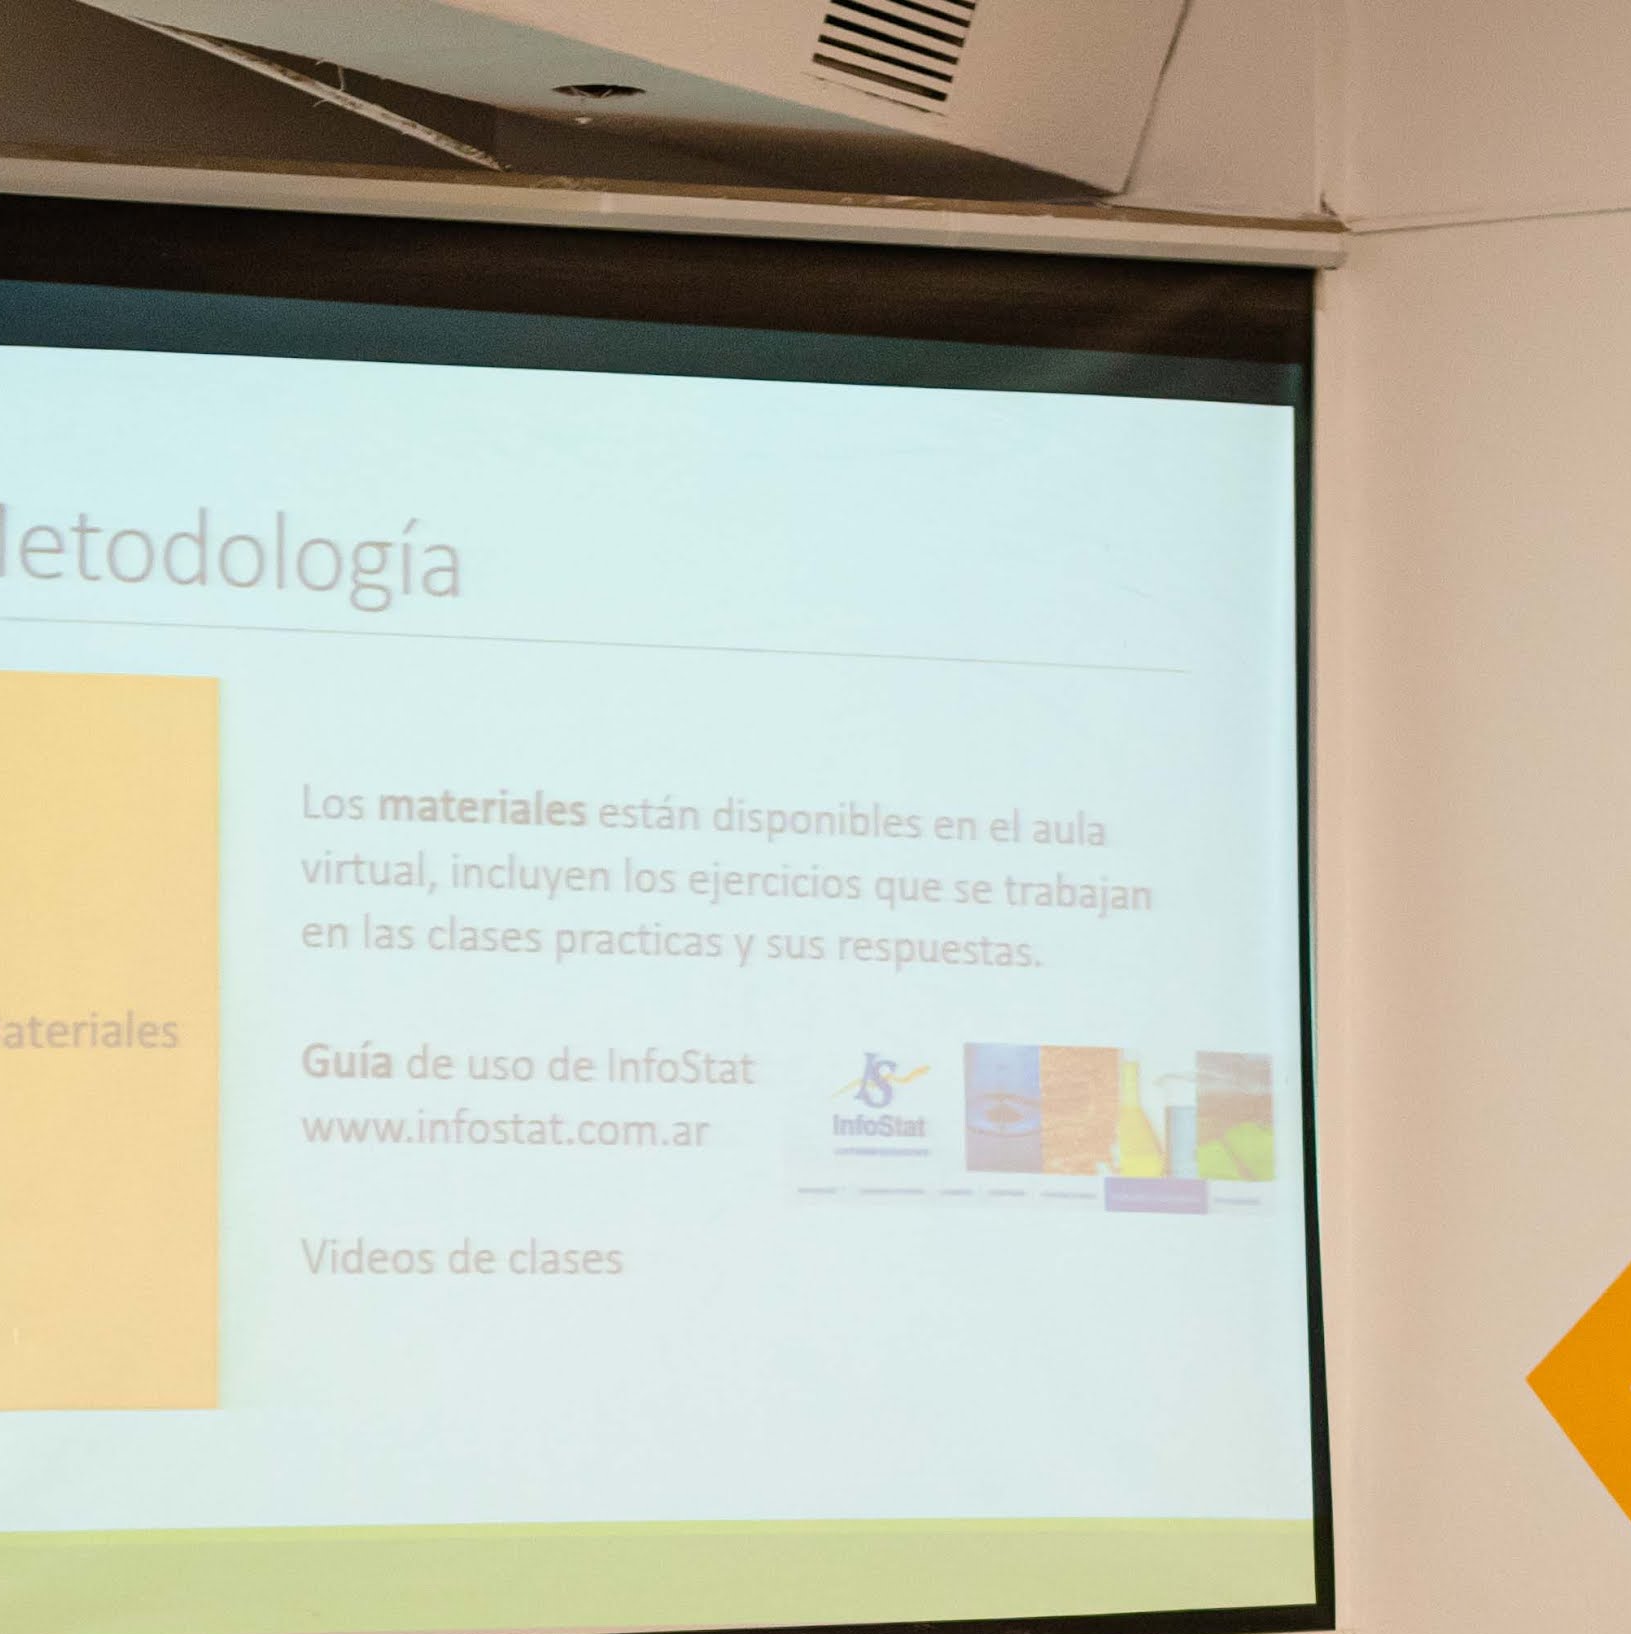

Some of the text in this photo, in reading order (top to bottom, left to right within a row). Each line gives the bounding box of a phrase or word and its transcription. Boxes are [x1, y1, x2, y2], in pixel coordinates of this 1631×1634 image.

[302, 783, 1107, 847] Los materiales están disponibles en el aula
[300, 848, 1153, 918] virtual, incluyen los ejercicios que se trabajan
[301, 914, 1043, 973] en las clases practicas y sus respuestas.
[301, 1039, 756, 1085] Guía de uso de InfoStat
[301, 1106, 712, 1147] www.infostat.com.ar
[832, 1113, 927, 1138] InfoStat
[448, 1236, 497, 1276] de
[508, 1238, 624, 1276] clases
